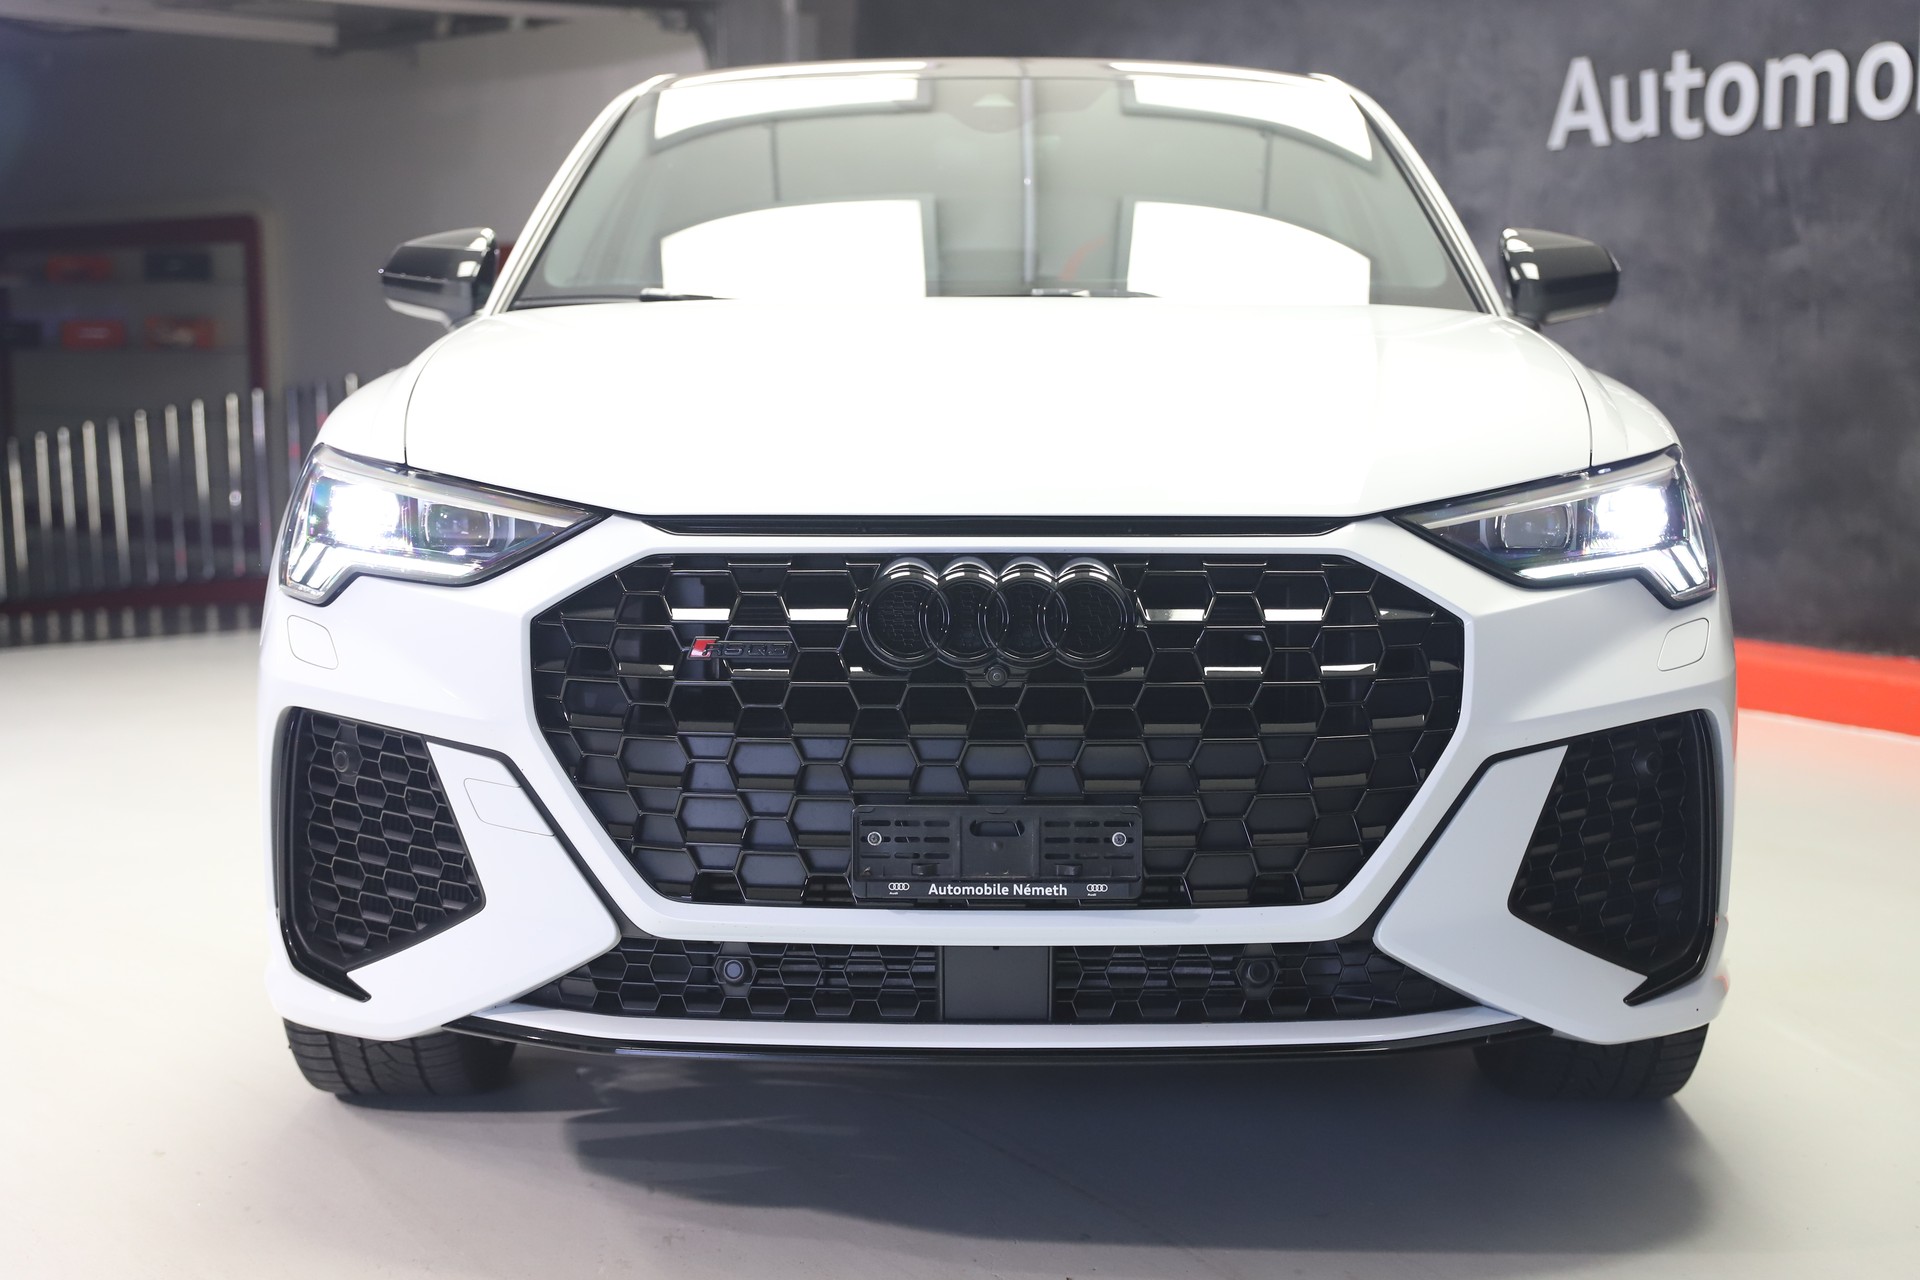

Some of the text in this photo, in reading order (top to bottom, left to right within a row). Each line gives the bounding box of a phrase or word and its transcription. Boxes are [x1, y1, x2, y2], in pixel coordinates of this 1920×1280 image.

[1547, 22, 1920, 152] Automo
[928, 883, 1068, 896] Automobile Németh
